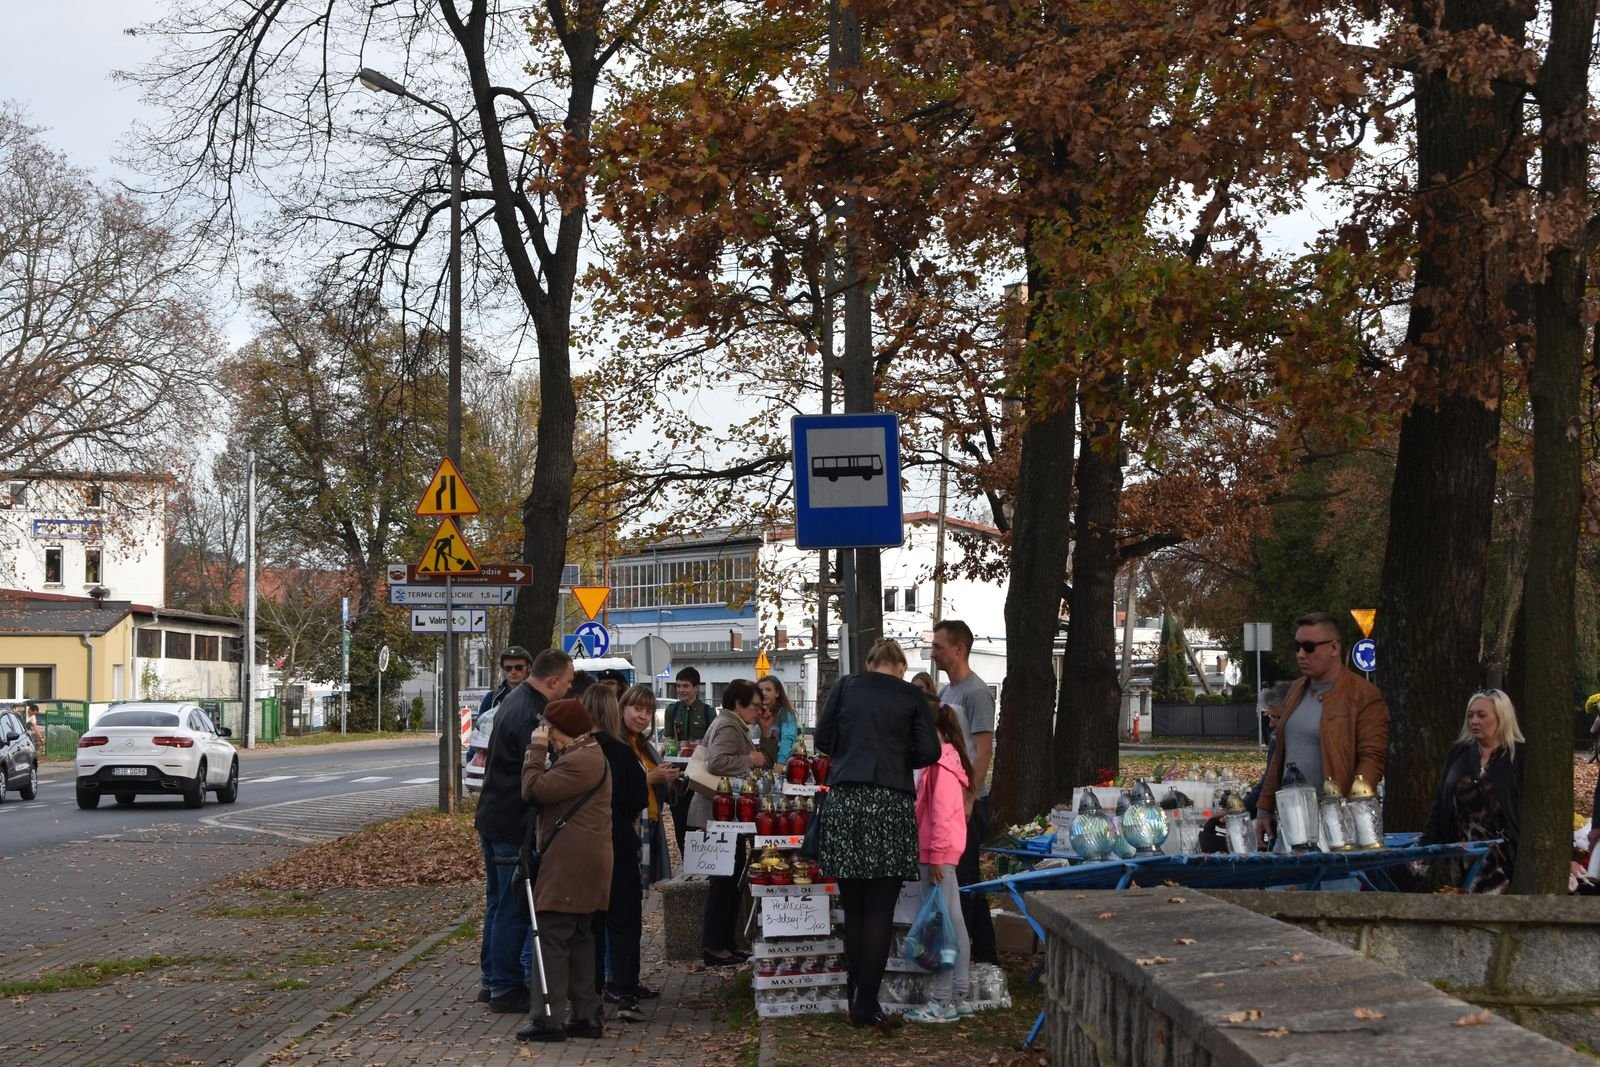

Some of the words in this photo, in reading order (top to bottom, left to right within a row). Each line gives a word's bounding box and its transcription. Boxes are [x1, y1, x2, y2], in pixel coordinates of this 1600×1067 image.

[434, 591, 473, 599] CIELICKIE
[480, 592, 491, 600] 1,5
[429, 615, 456, 625] Valmt
[767, 944, 816, 954] MAX-POL
